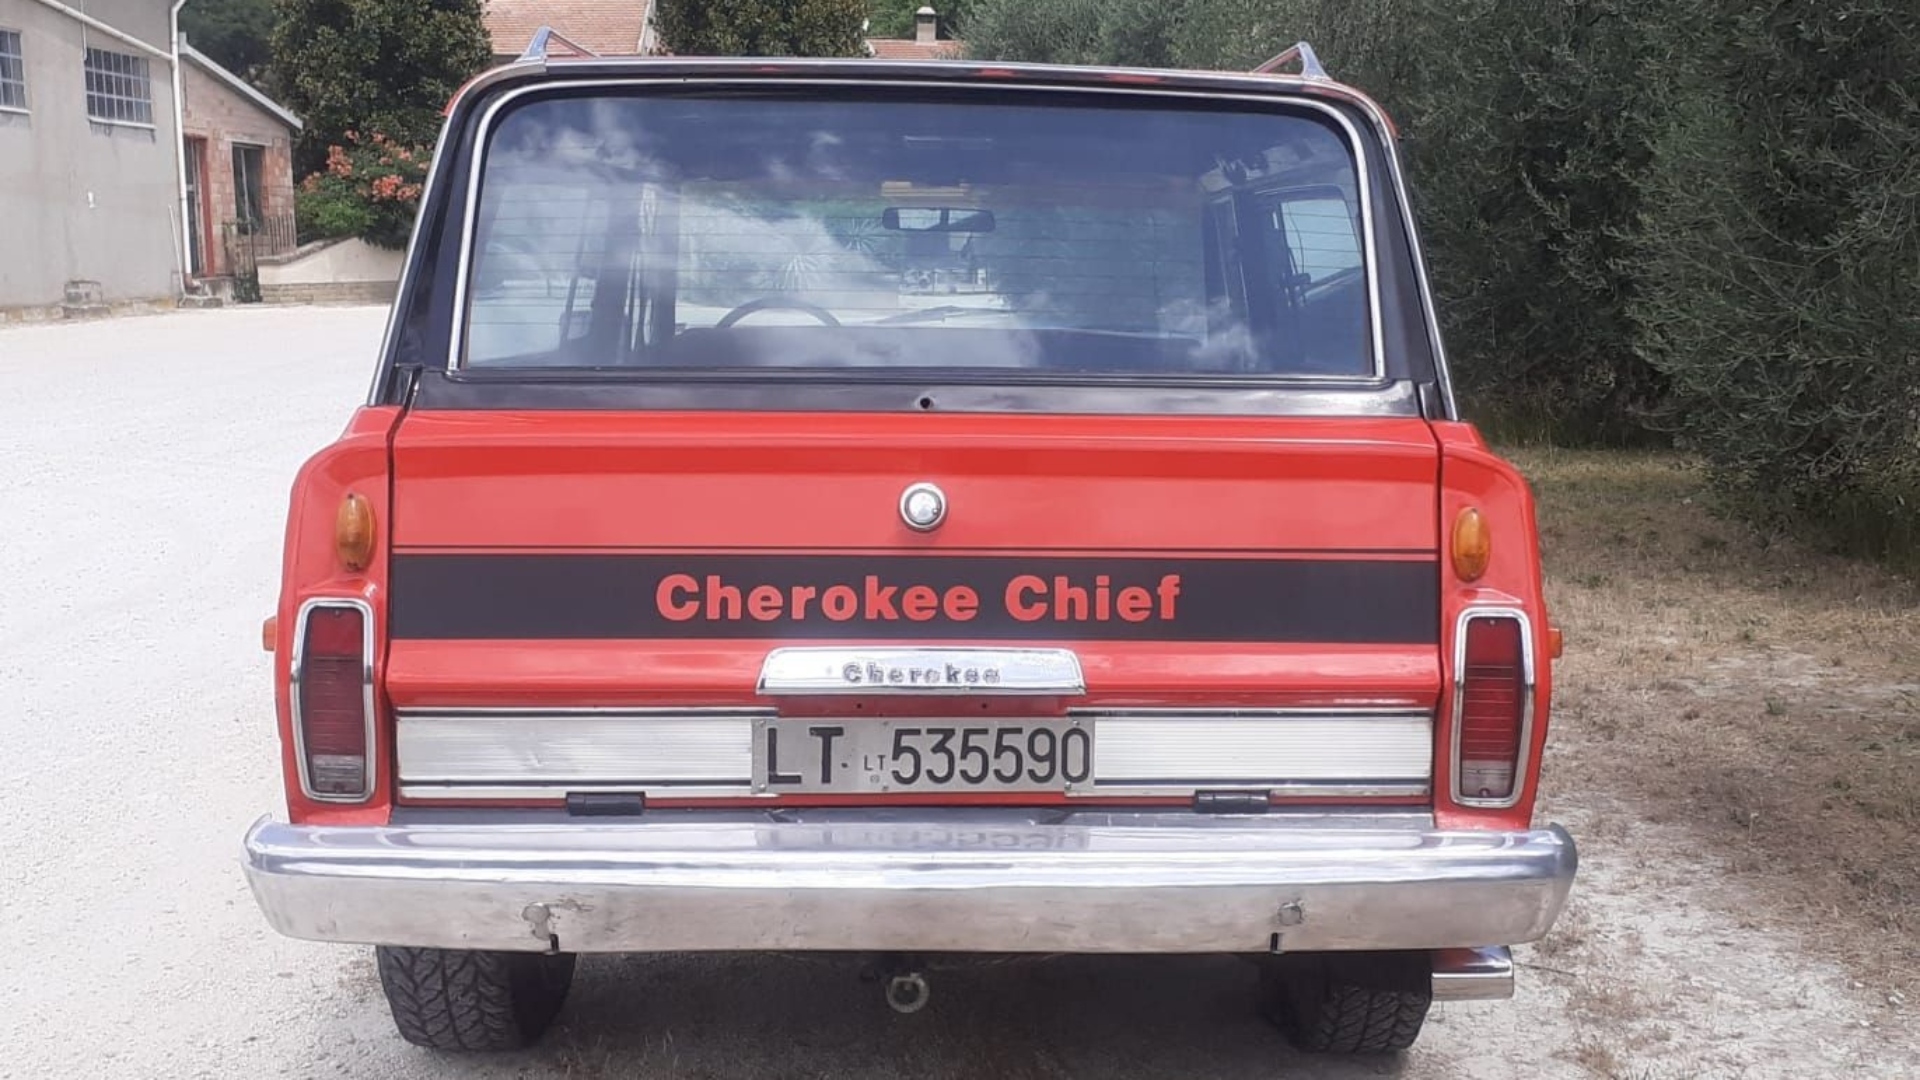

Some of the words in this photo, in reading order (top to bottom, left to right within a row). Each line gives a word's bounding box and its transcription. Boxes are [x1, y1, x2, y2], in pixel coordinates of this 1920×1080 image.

[655, 573, 980, 622] Cherokee
[1005, 574, 1182, 623] Chief
[842, 662, 1001, 685] Cherokee
[767, 726, 844, 785] LT
[863, 754, 887, 771] LT
[891, 727, 1091, 785] 535590
